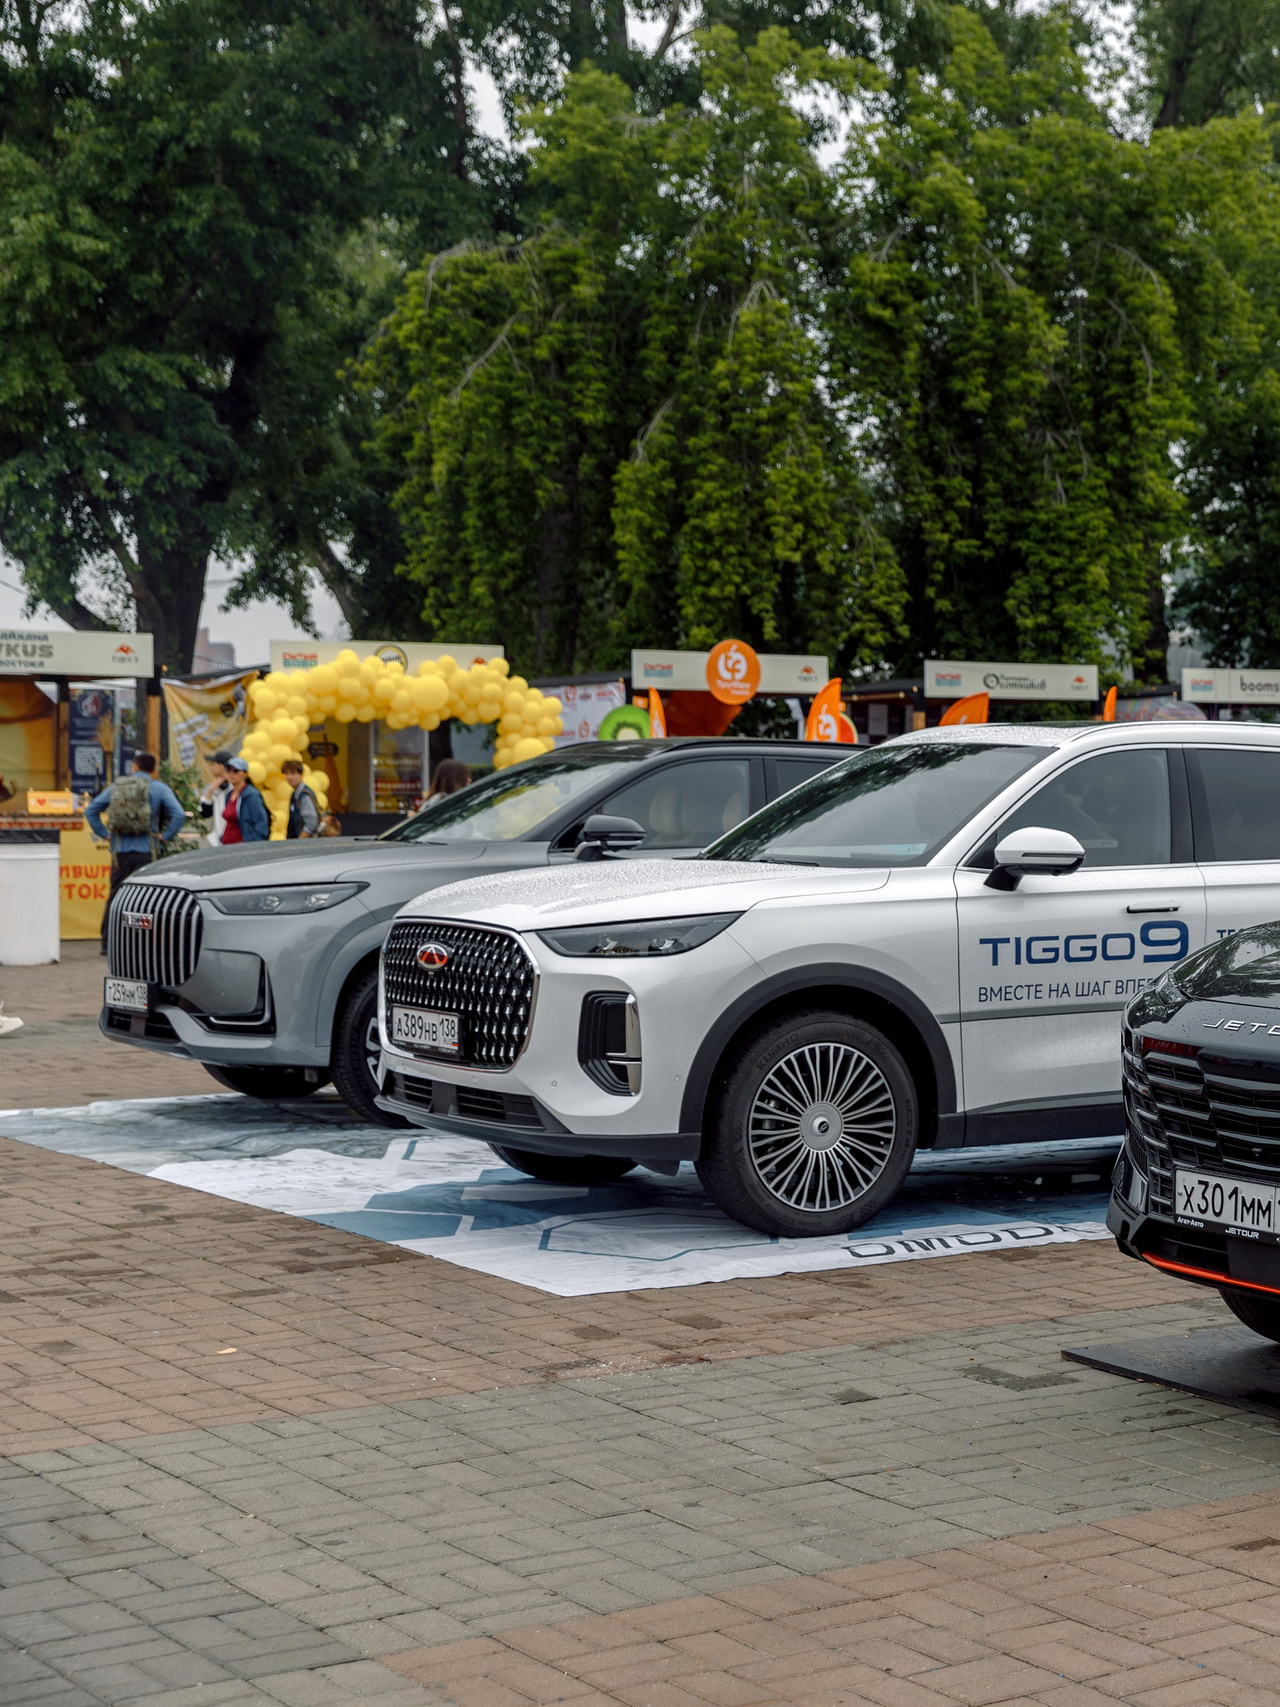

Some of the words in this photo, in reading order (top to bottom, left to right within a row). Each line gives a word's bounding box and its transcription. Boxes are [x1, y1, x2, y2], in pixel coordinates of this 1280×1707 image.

[1240, 675, 1280, 693] booms
[60, 883, 106, 900] ТОК
[978, 984, 1043, 1002] ВМЕСТЕ
[1049, 983, 1071, 999] НА
[1075, 980, 1111, 997] ШАГ
[440, 1017, 456, 1038] 138
[1225, 1227, 1259, 1239] JETOUR
